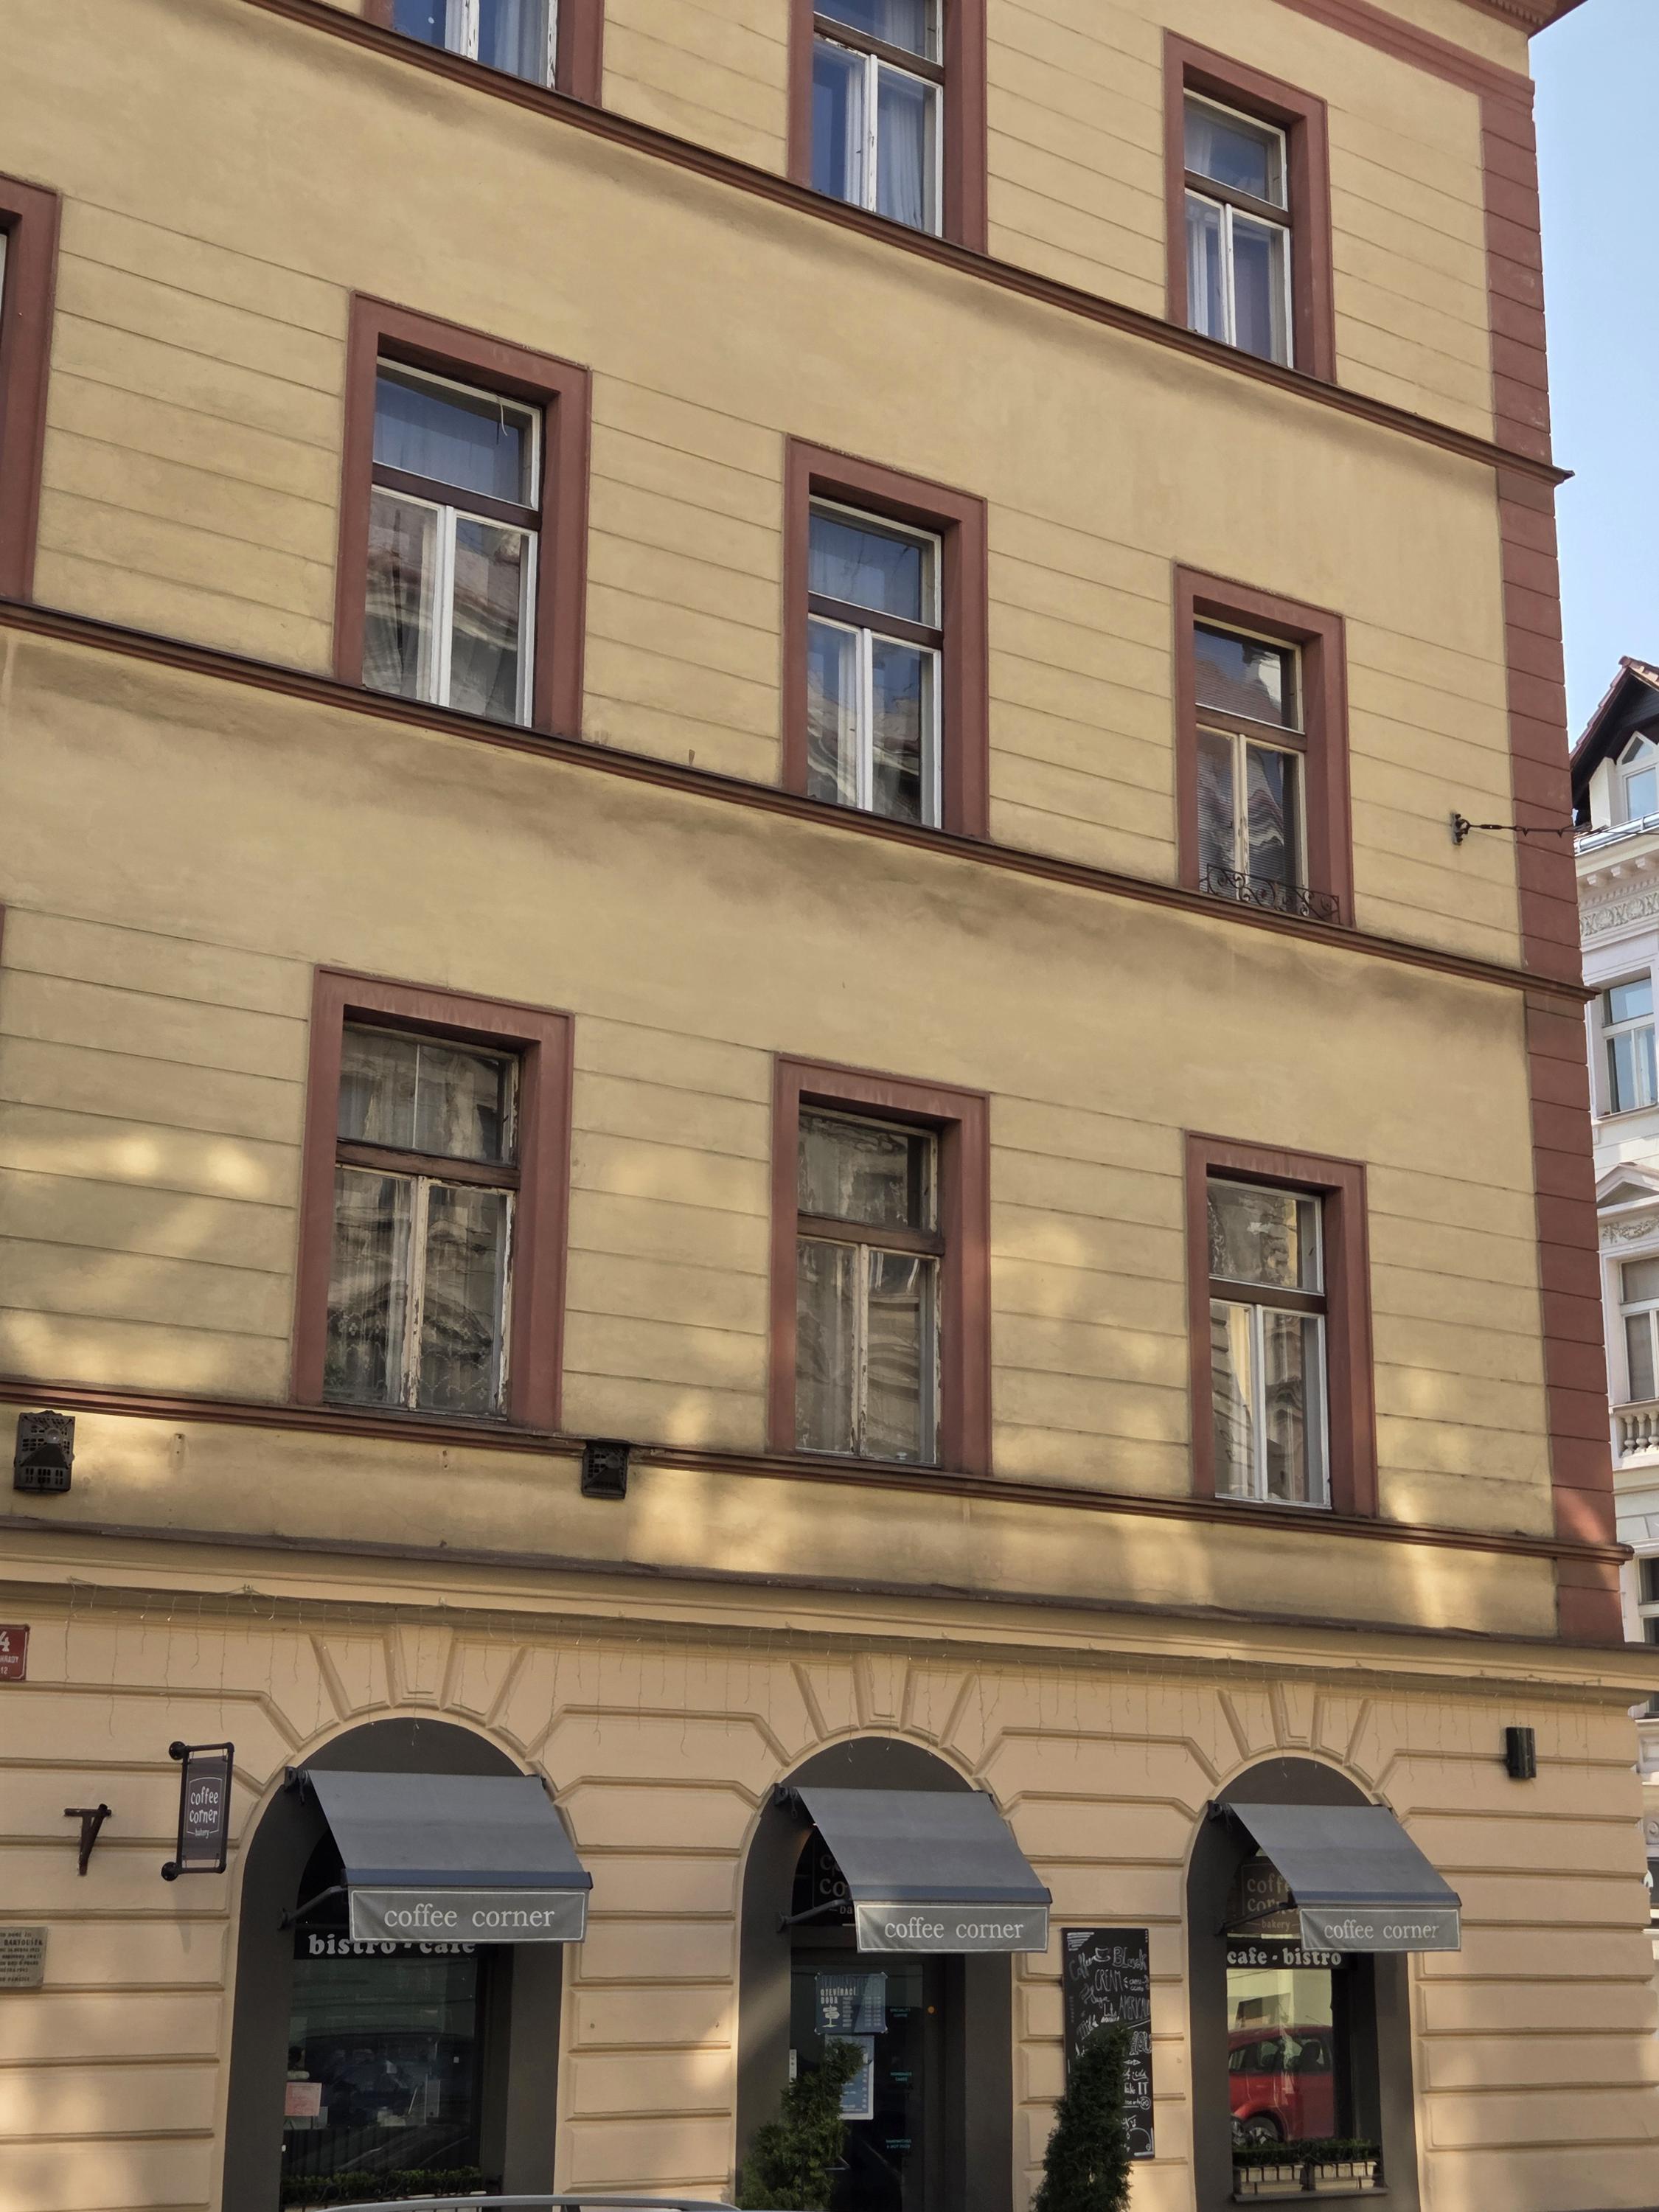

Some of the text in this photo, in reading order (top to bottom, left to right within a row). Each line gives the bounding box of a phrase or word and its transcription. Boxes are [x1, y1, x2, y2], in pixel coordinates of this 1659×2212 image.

[190, 1786, 219, 1806] coffee
[189, 1809, 218, 1824] corner
[383, 1903, 555, 1927] coffee corner
[884, 1917, 1024, 1938] coffee corner
[1262, 1919, 1291, 1932] bakery
[1324, 1919, 1439, 1939] coffee corner
[308, 1934, 396, 1955] bistro
[1227, 1947, 1267, 1965] cafe
[1282, 1947, 1341, 1966] bistro
